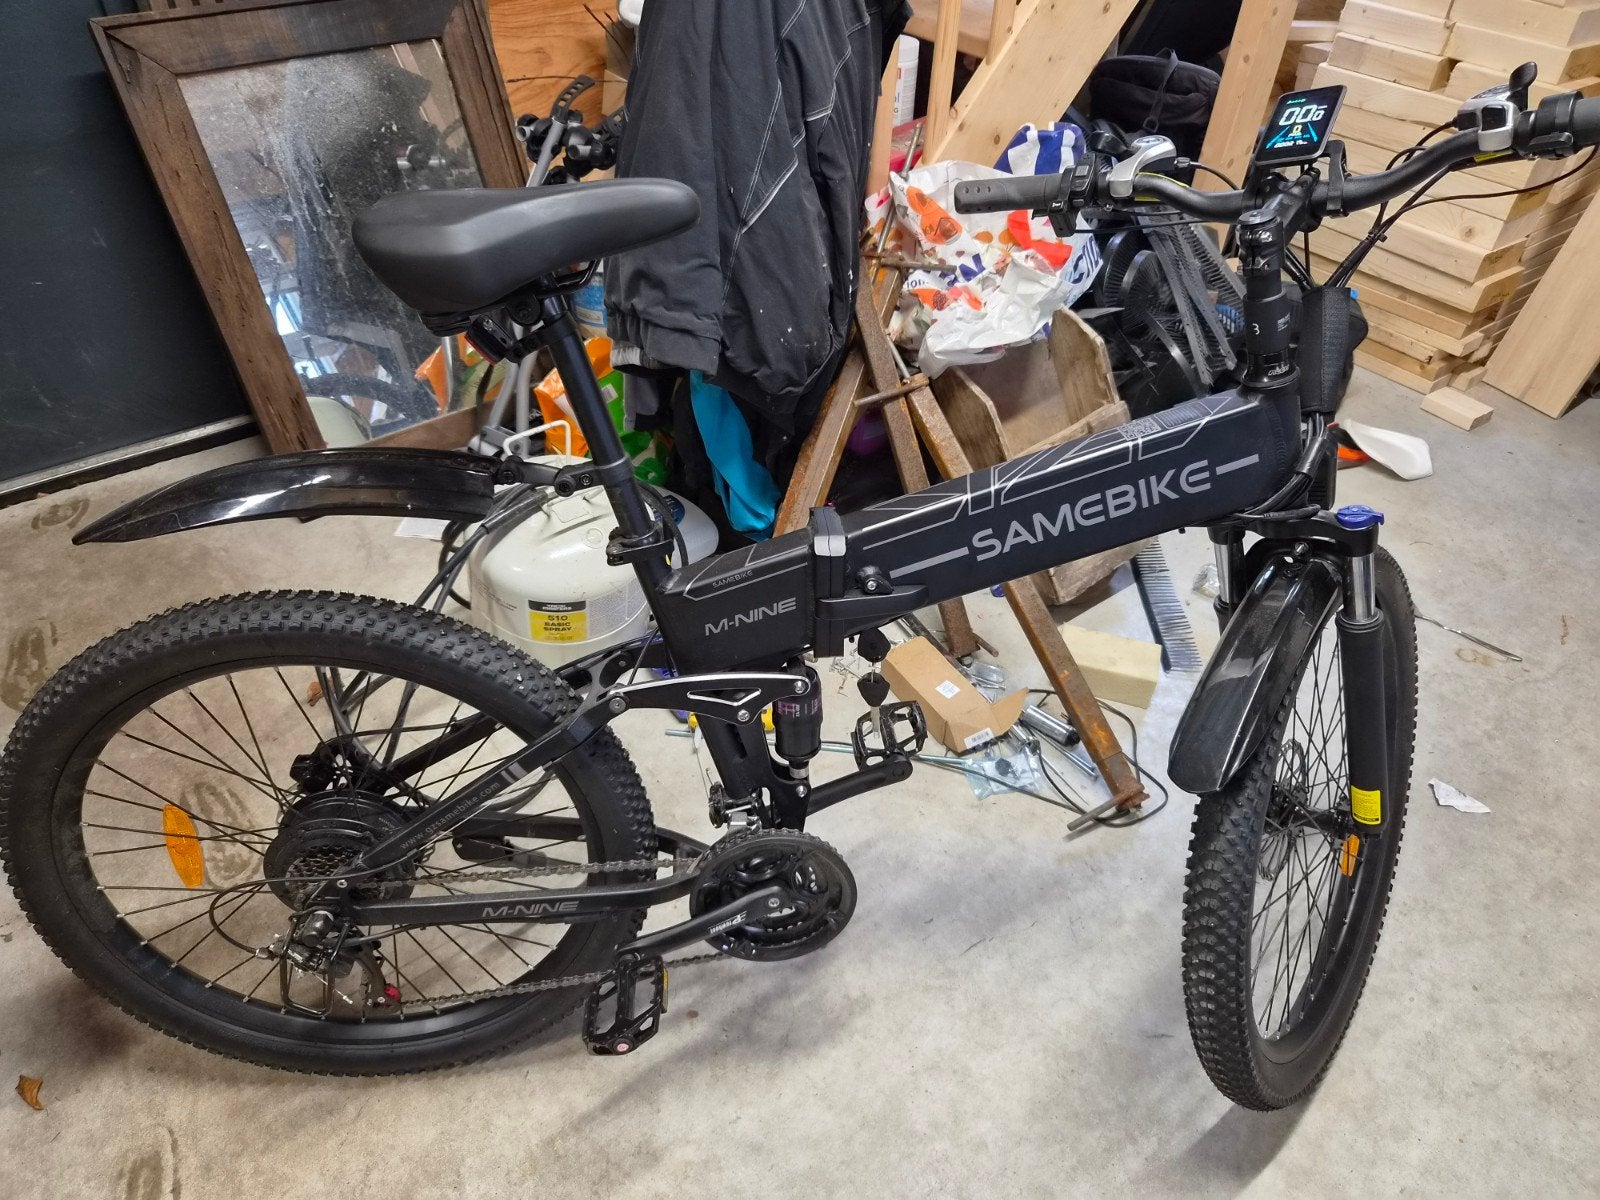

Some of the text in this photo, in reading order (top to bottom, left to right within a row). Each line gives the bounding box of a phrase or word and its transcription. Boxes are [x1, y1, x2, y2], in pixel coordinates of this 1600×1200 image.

[972, 459, 1211, 562] SAMEBIKE
[712, 569, 753, 588] SAMEBIKE
[704, 597, 797, 636] M-NINE
[482, 901, 579, 918] M-NINE
